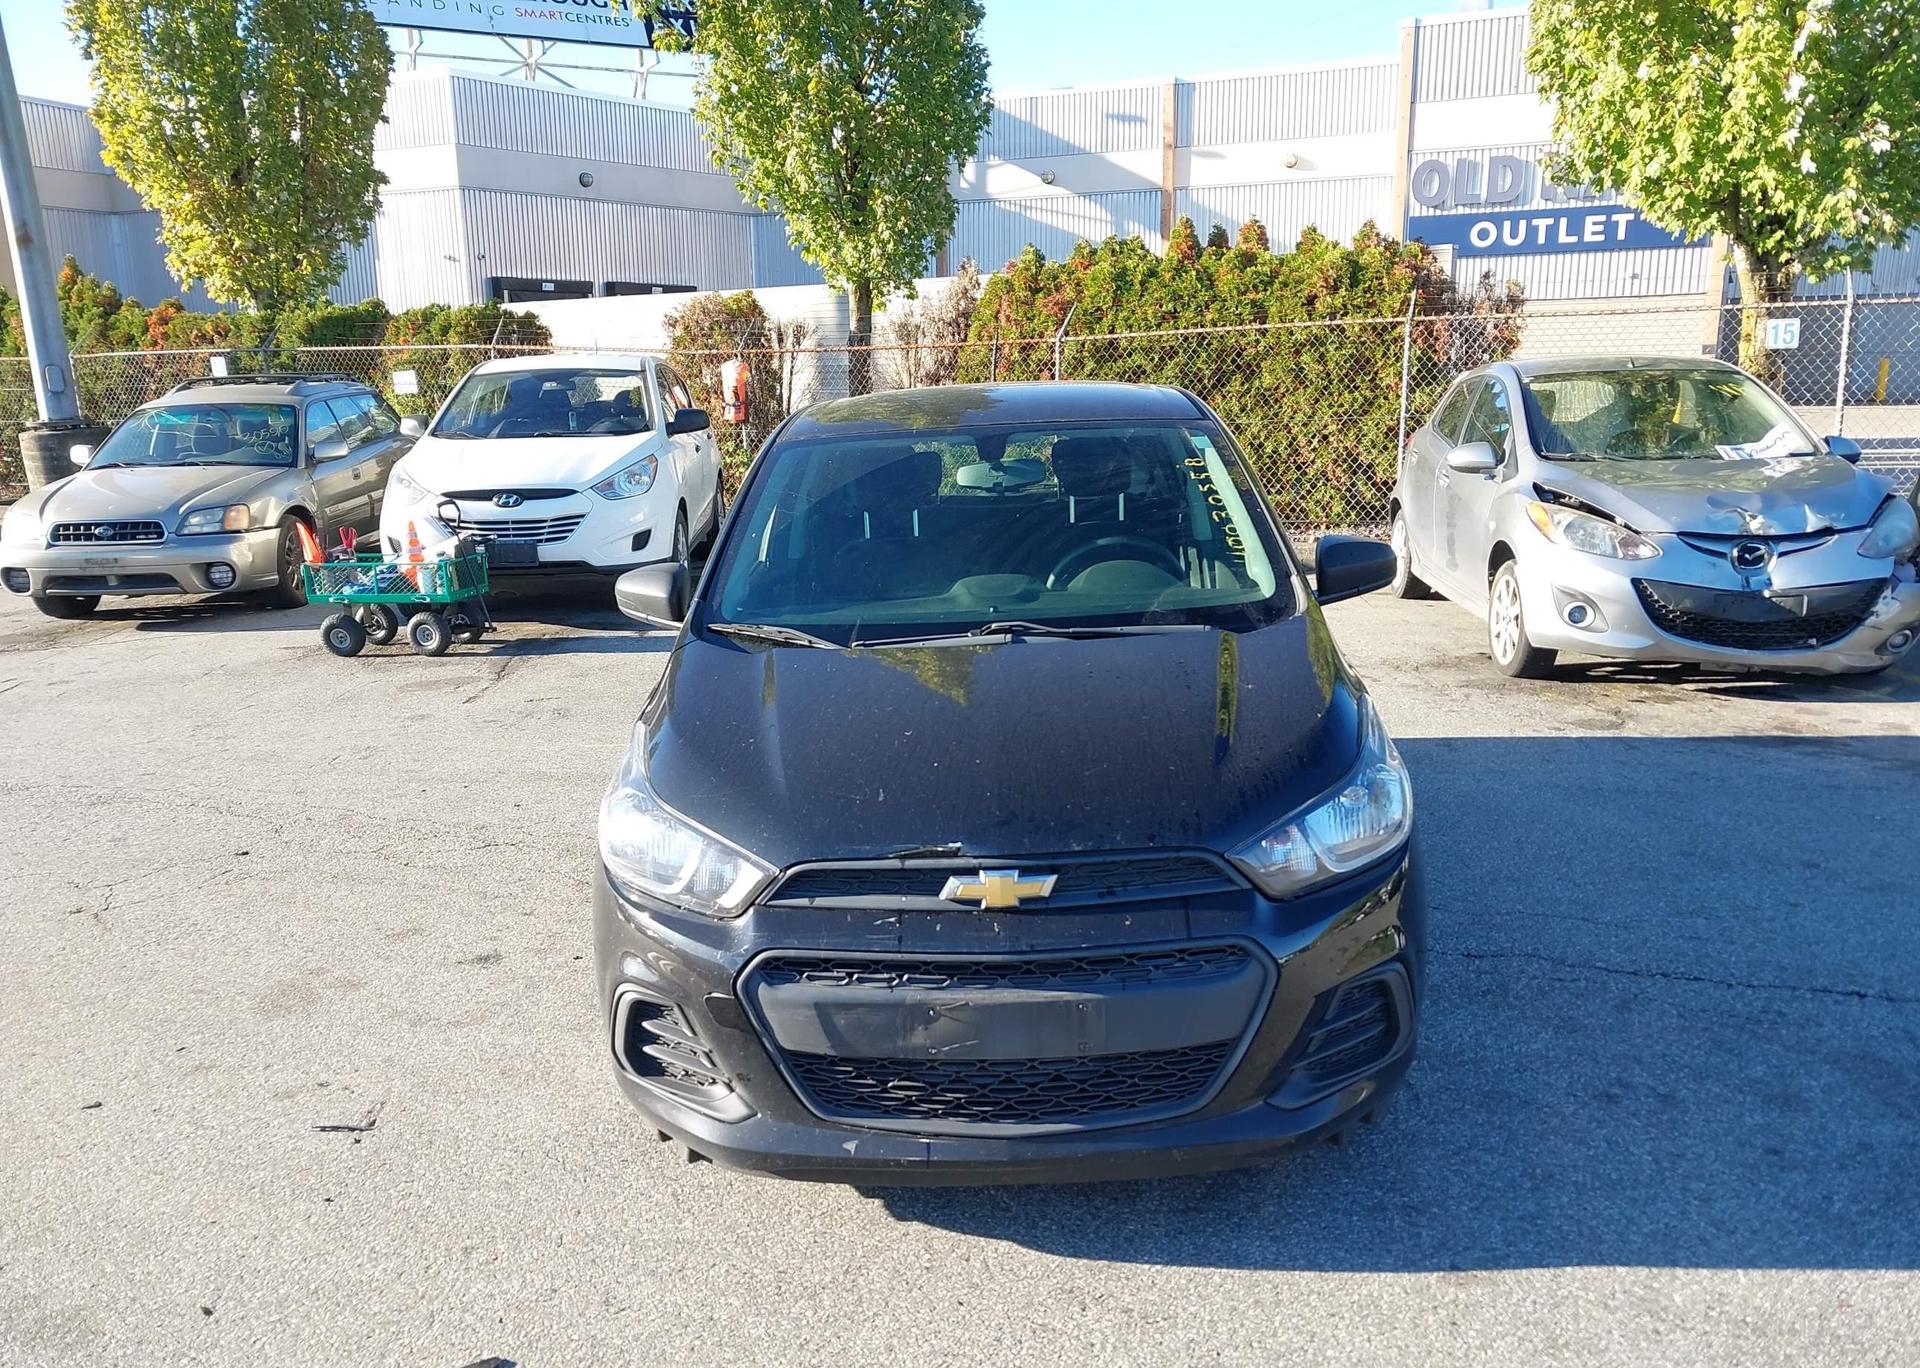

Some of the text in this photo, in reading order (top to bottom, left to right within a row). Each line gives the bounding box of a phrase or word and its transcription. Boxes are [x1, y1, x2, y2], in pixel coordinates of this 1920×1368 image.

[515, 7, 630, 27] SMARTCENTRES
[1412, 155, 1525, 207] OLD
[1470, 213, 1635, 249] OUTLET
[1771, 322, 1796, 346] 15
